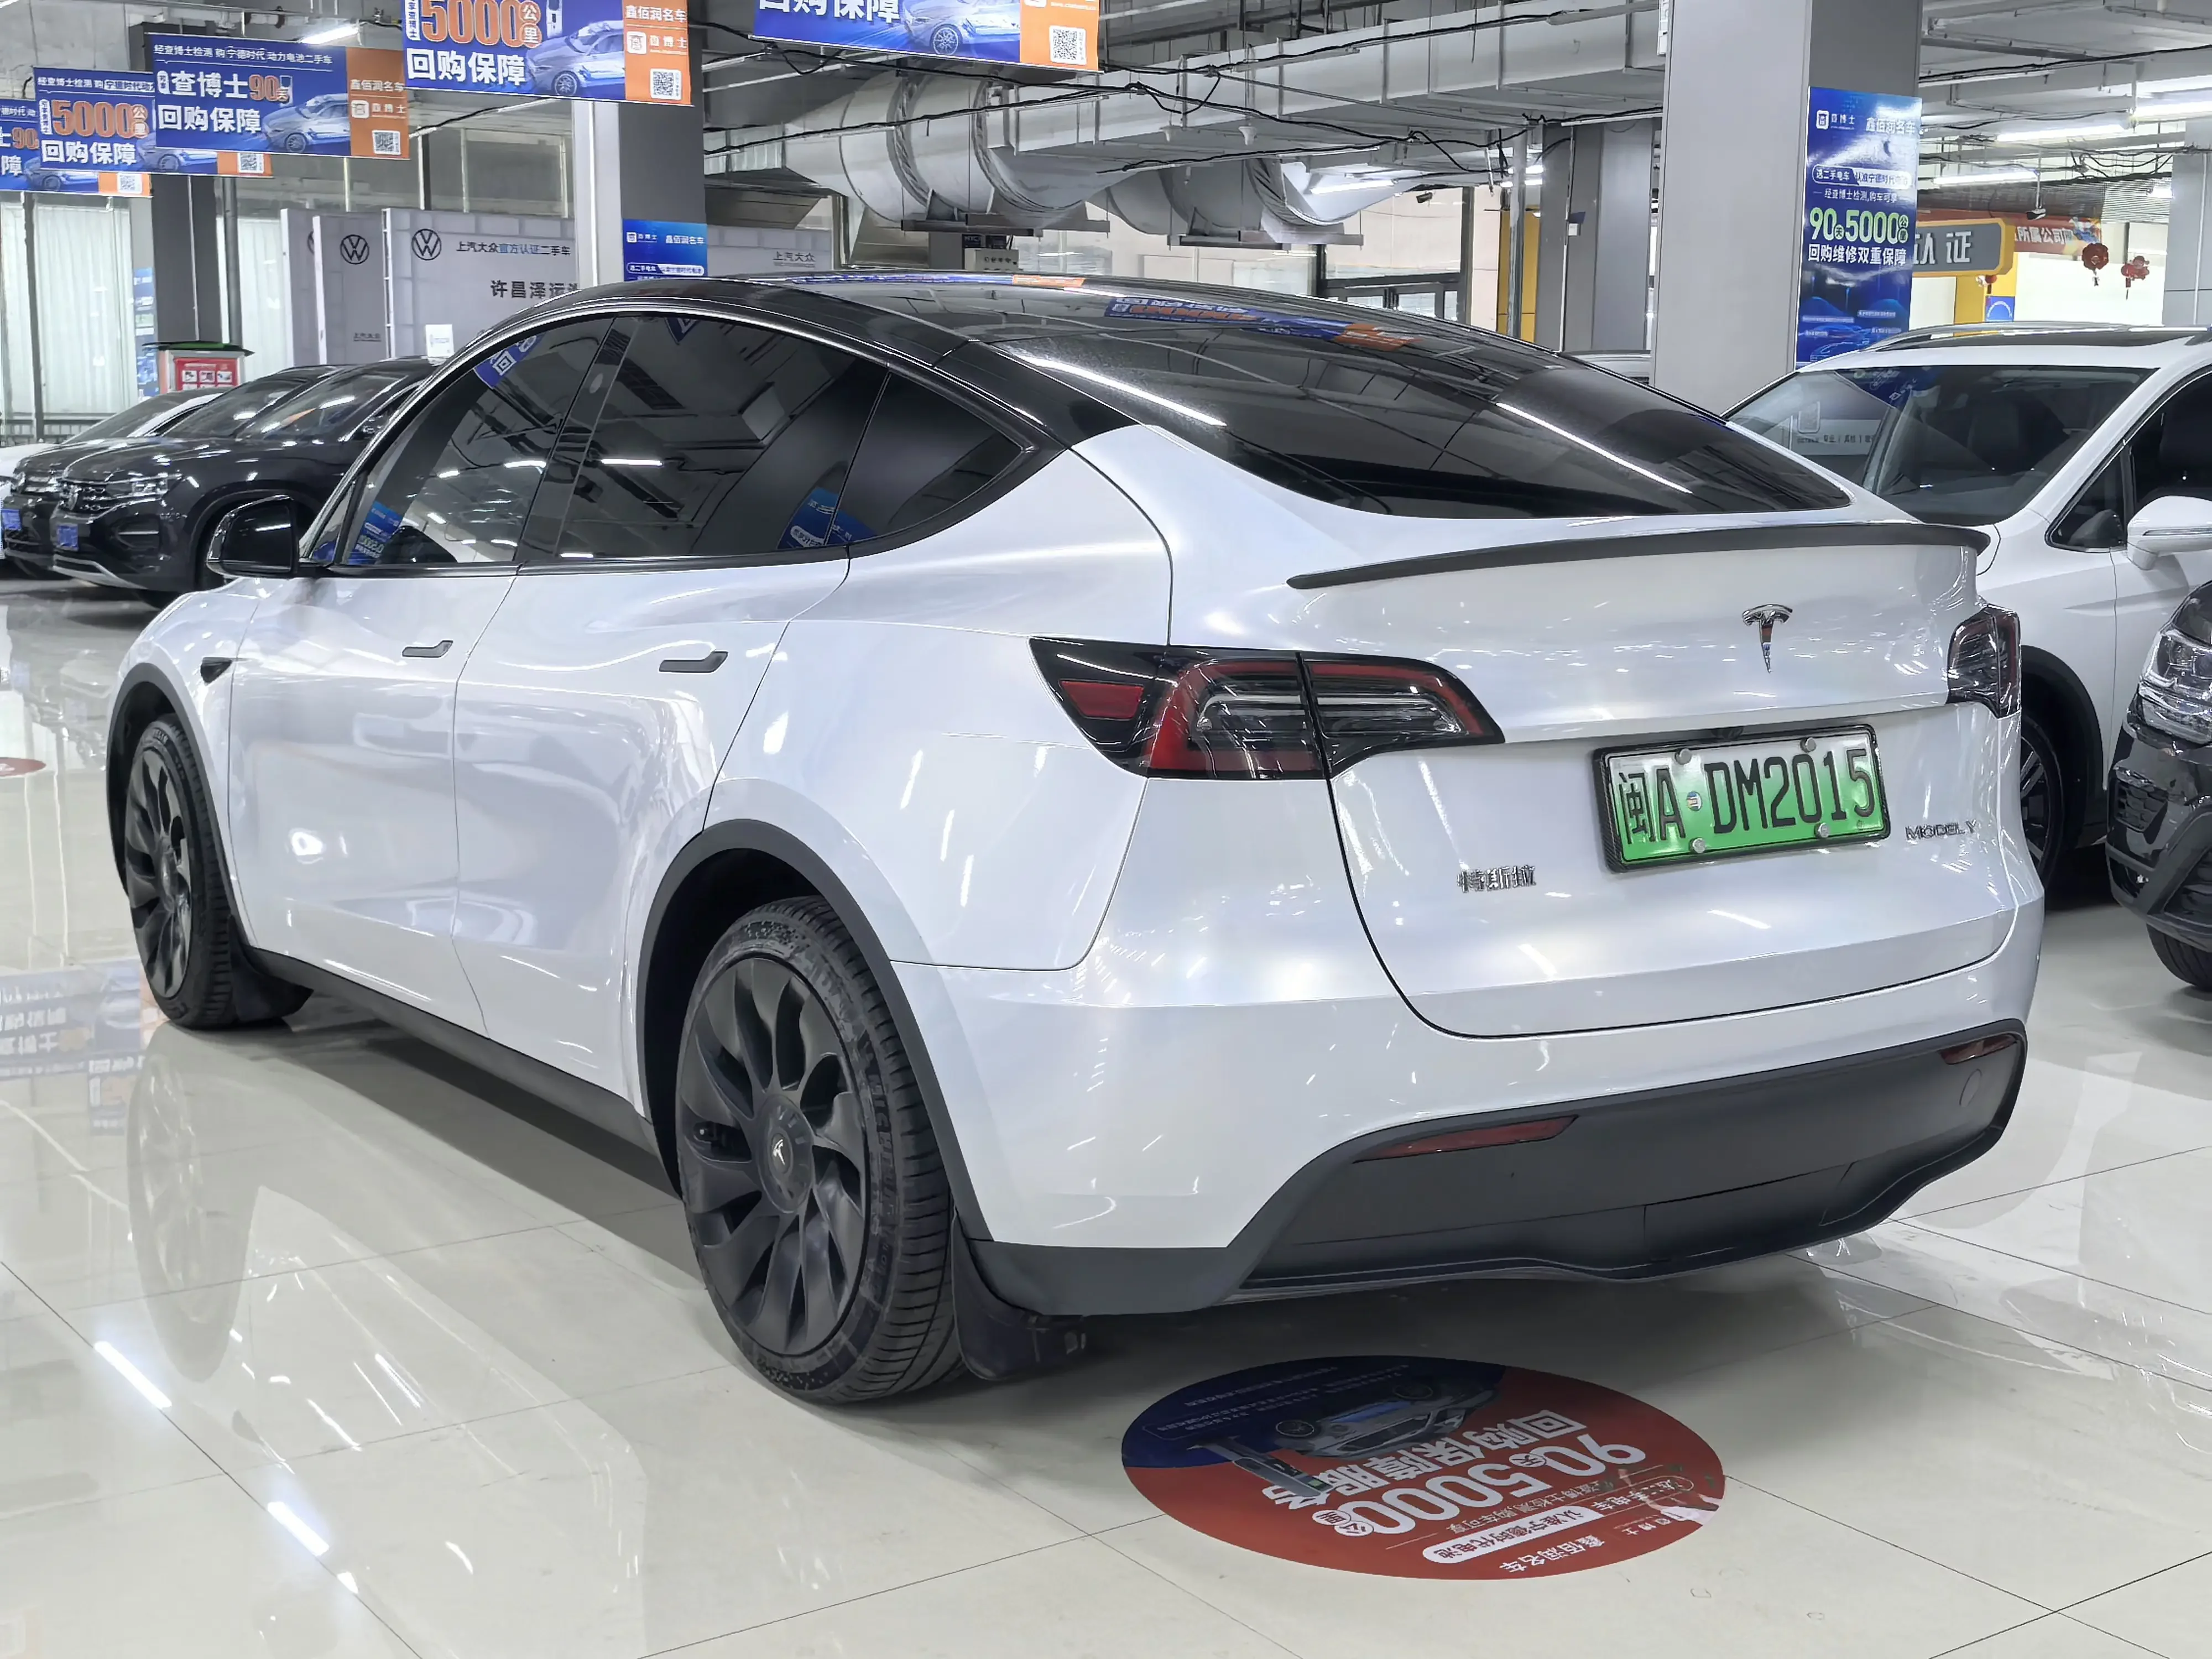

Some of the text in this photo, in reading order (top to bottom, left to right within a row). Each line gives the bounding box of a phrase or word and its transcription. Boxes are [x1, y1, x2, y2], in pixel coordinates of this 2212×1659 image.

[406, 48, 526, 86] 回购保障
[158, 105, 262, 134] 回购保障
[1, 155, 22, 176] 障
[41, 139, 137, 165] 回购保障
[456, 241, 571, 255] 上汽大众官方认证二手车
[1808, 243, 1907, 267] 回购维修双重保障
[1913, 231, 1972, 265] 认证
[1619, 748, 1875, 844] 闽A DM2015
[1905, 818, 1976, 841] MODEL Y
[1457, 864, 1536, 894] 特斯拉
[1499, 1534, 1605, 1573] 鑫佰润名车
